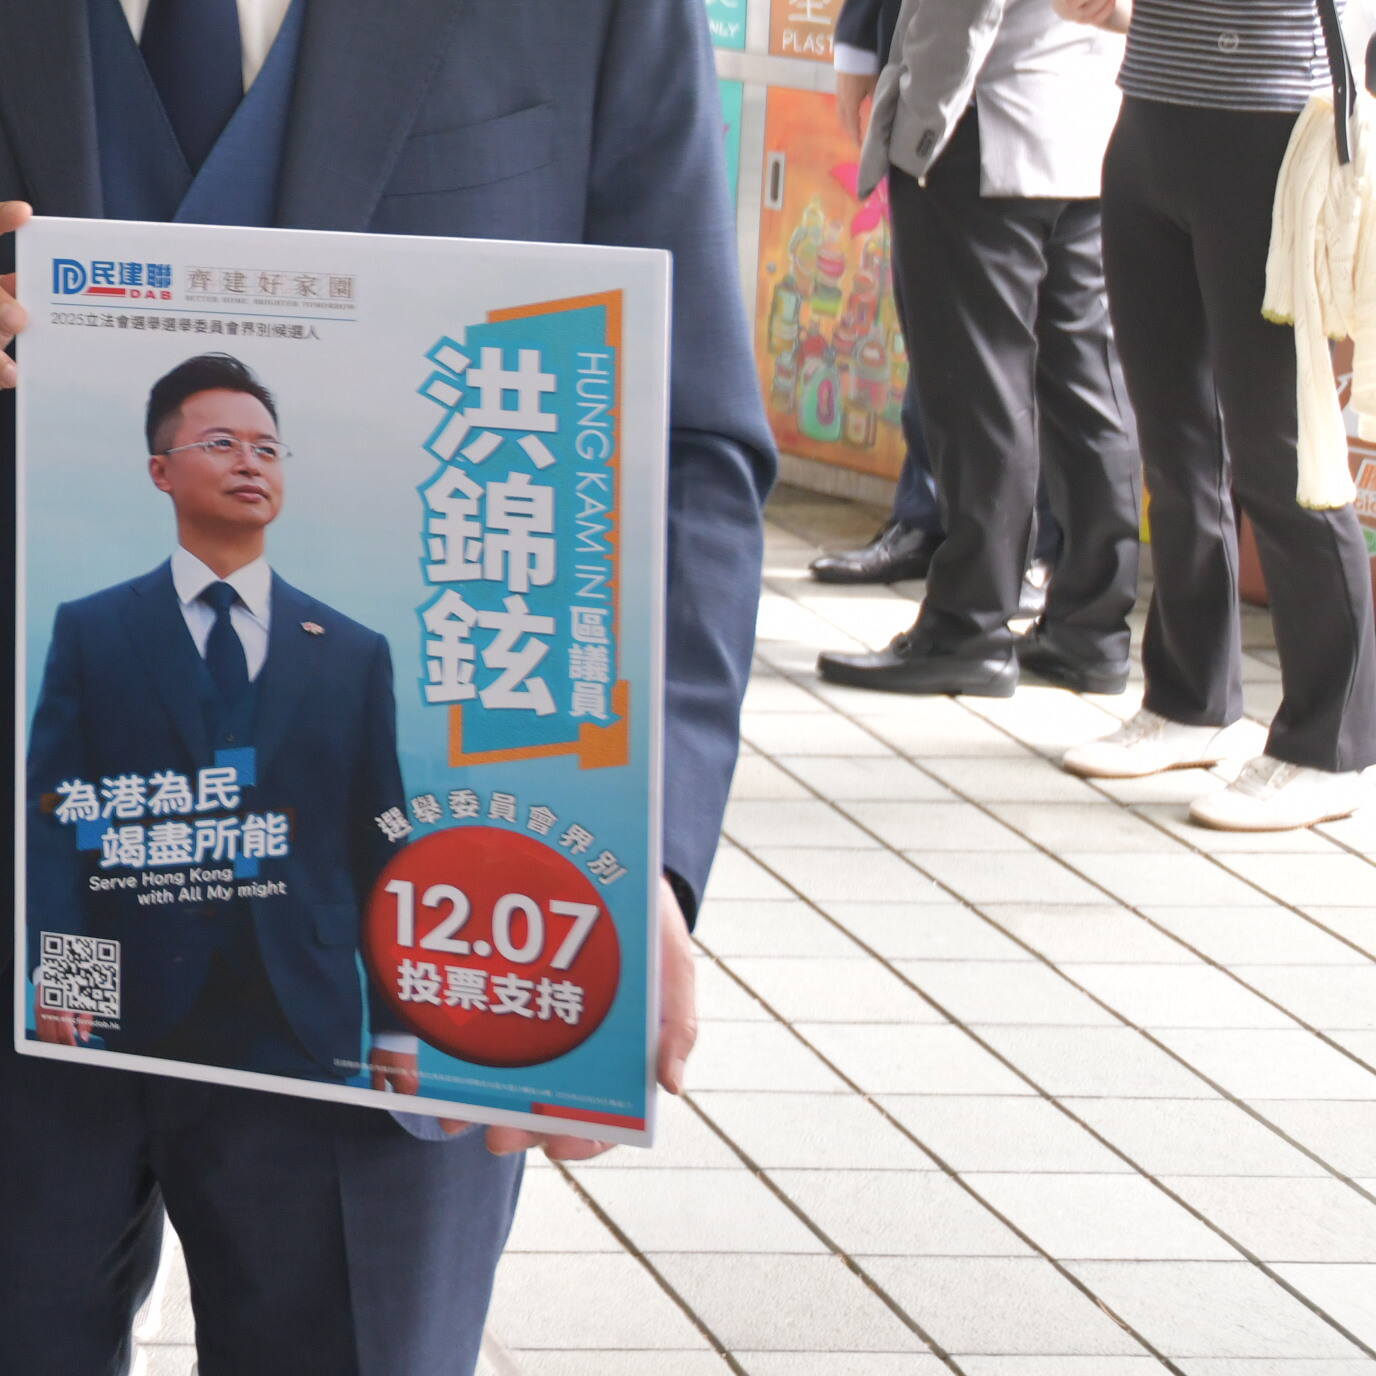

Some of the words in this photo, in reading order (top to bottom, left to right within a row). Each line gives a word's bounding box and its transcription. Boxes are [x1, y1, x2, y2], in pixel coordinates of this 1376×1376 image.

[91, 260, 172, 288] 民建聯
[129, 288, 172, 301] DAB
[188, 267, 354, 299] 齊建好家園
[575, 351, 610, 461] HUNG
[422, 344, 559, 717] 洪錦鉉
[574, 472, 608, 553] KAM
[574, 565, 606, 599] IN
[568, 605, 610, 721] 區議員
[54, 766, 240, 824] 為港為民
[99, 813, 290, 871] 竭盡所能
[374, 788, 628, 887] 選舉委員會界別
[89, 872, 137, 892] Serve
[141, 868, 186, 890] Hong
[189, 865, 234, 886] Kong
[137, 888, 174, 906] with
[177, 885, 204, 903] All
[206, 883, 235, 904] My
[237, 879, 287, 901] might
[384, 878, 600, 971] 12.07
[396, 959, 585, 1025] 投票支持
